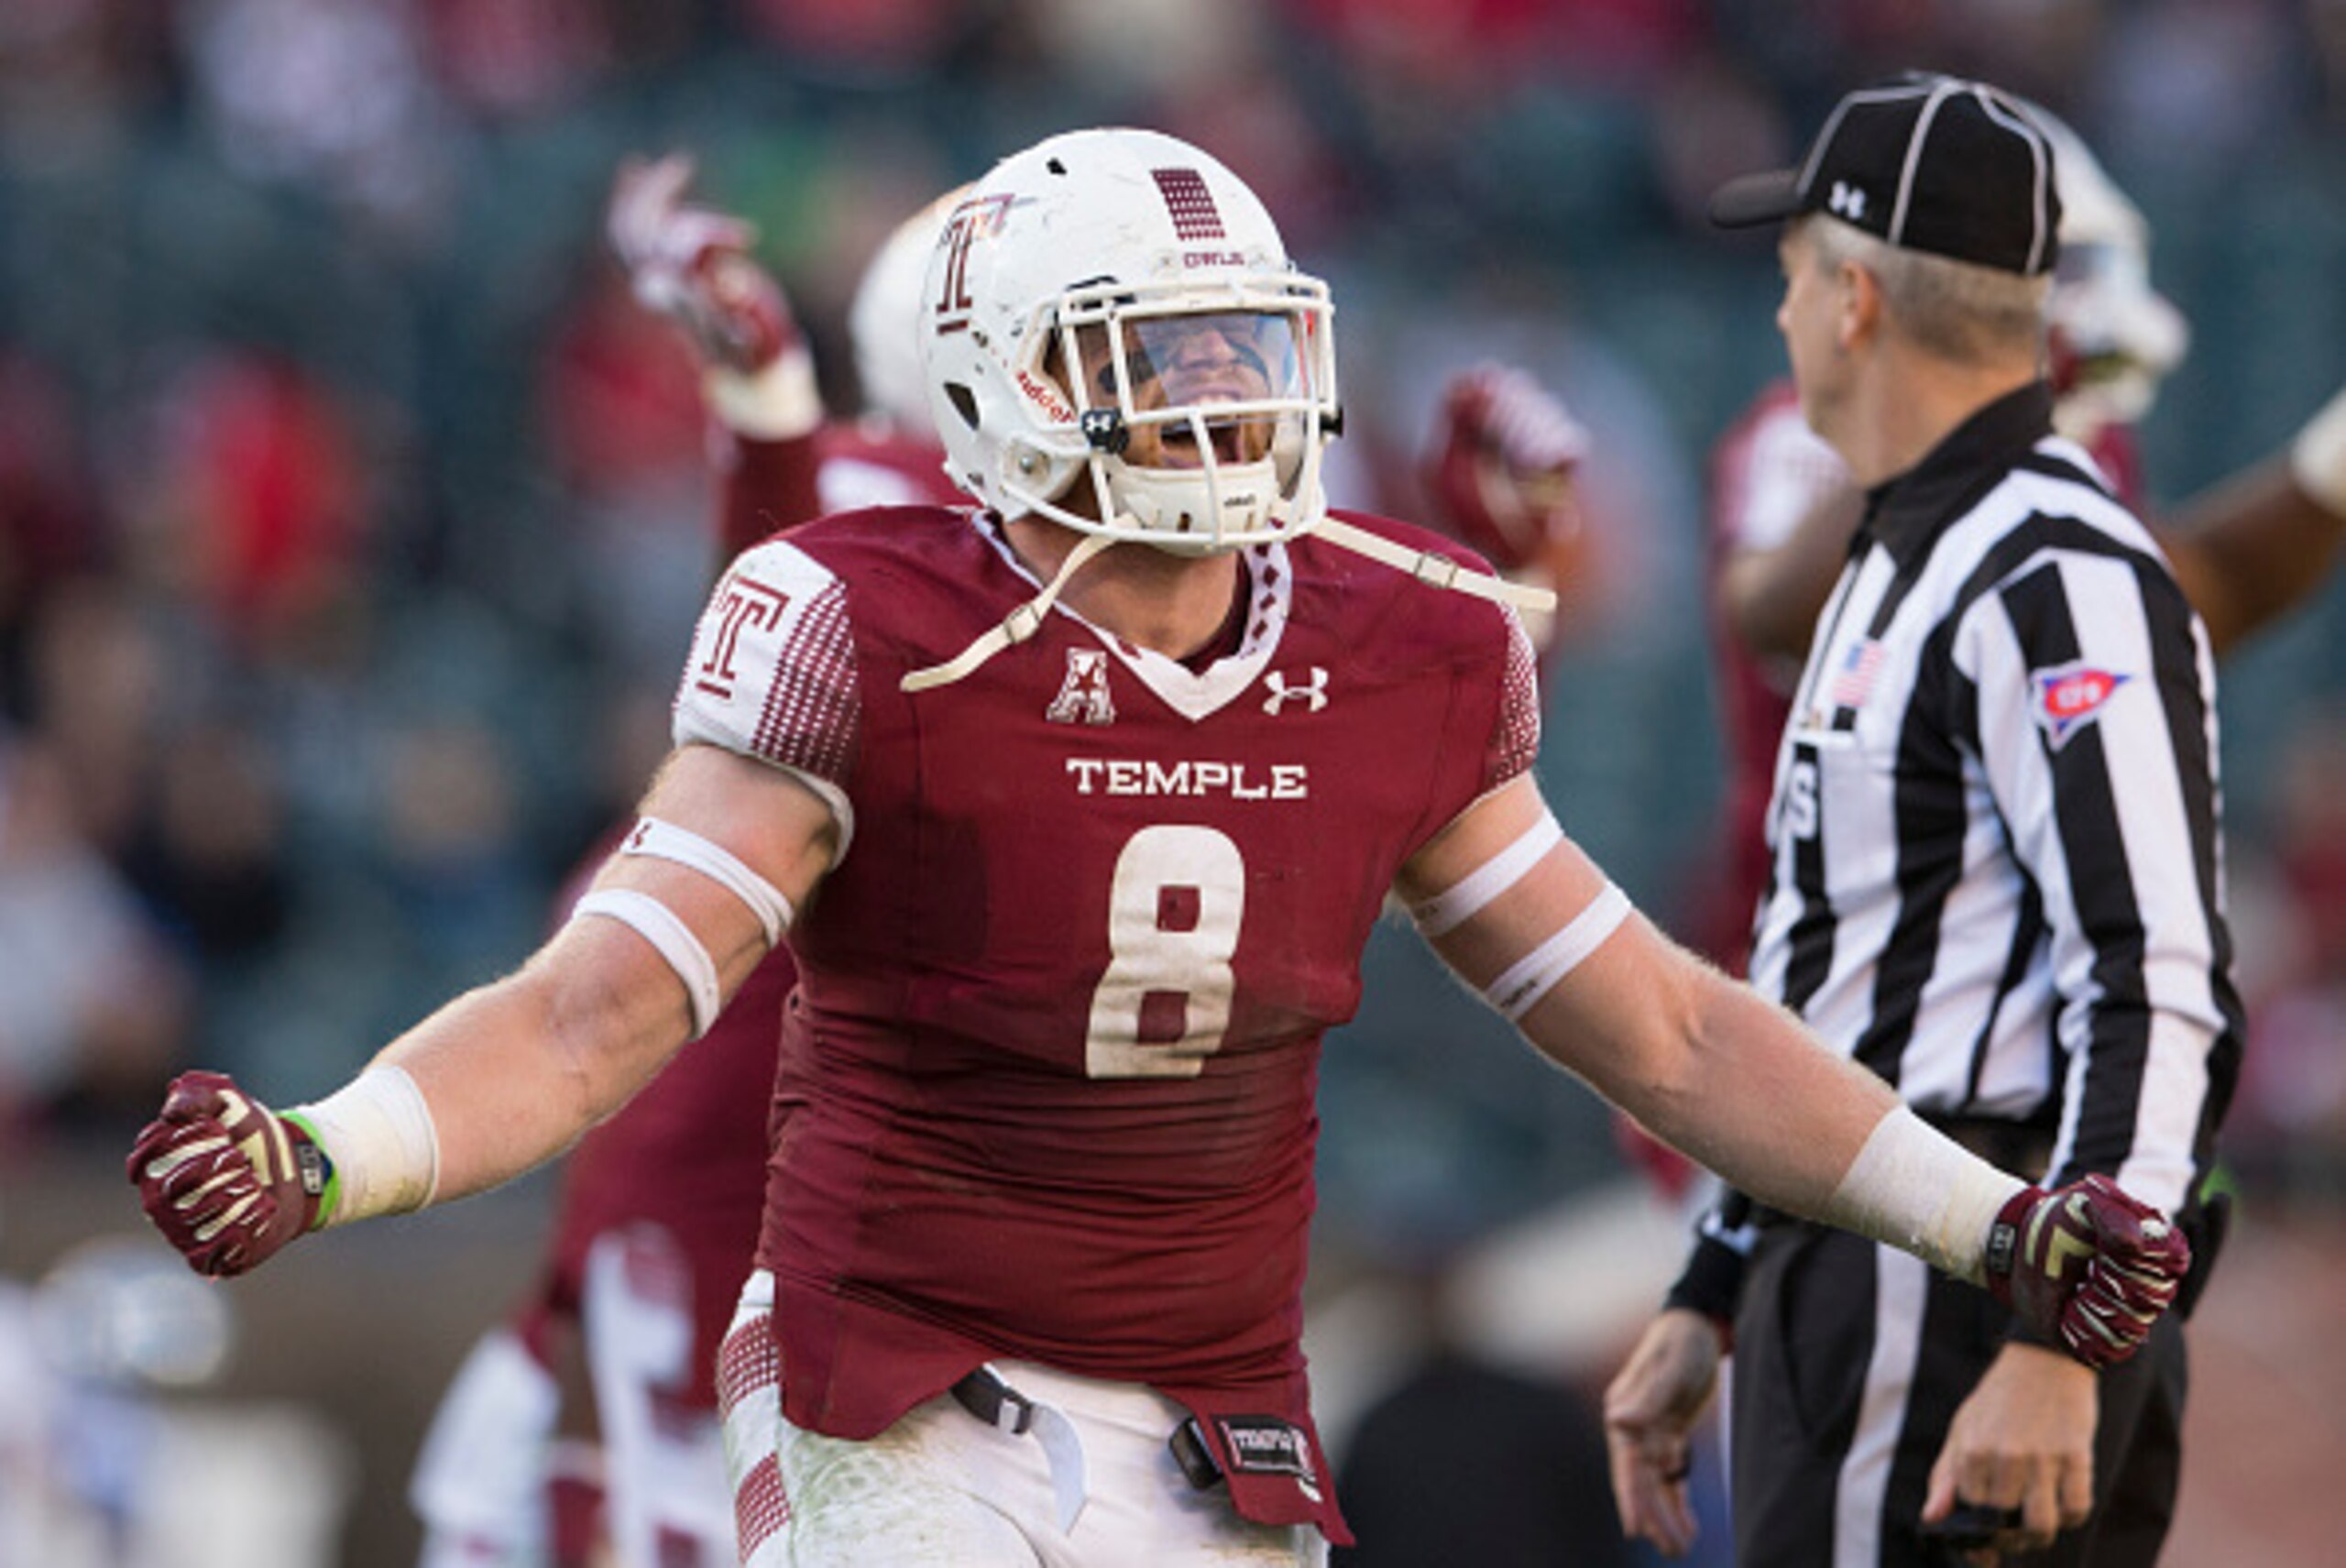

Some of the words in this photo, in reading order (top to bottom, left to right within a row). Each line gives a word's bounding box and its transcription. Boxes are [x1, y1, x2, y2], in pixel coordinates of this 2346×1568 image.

[1183, 251, 1245, 269] OWLS
[695, 570, 792, 700] T
[1065, 757, 1308, 800] TEMPLE
[1085, 823, 1246, 1080] 8
